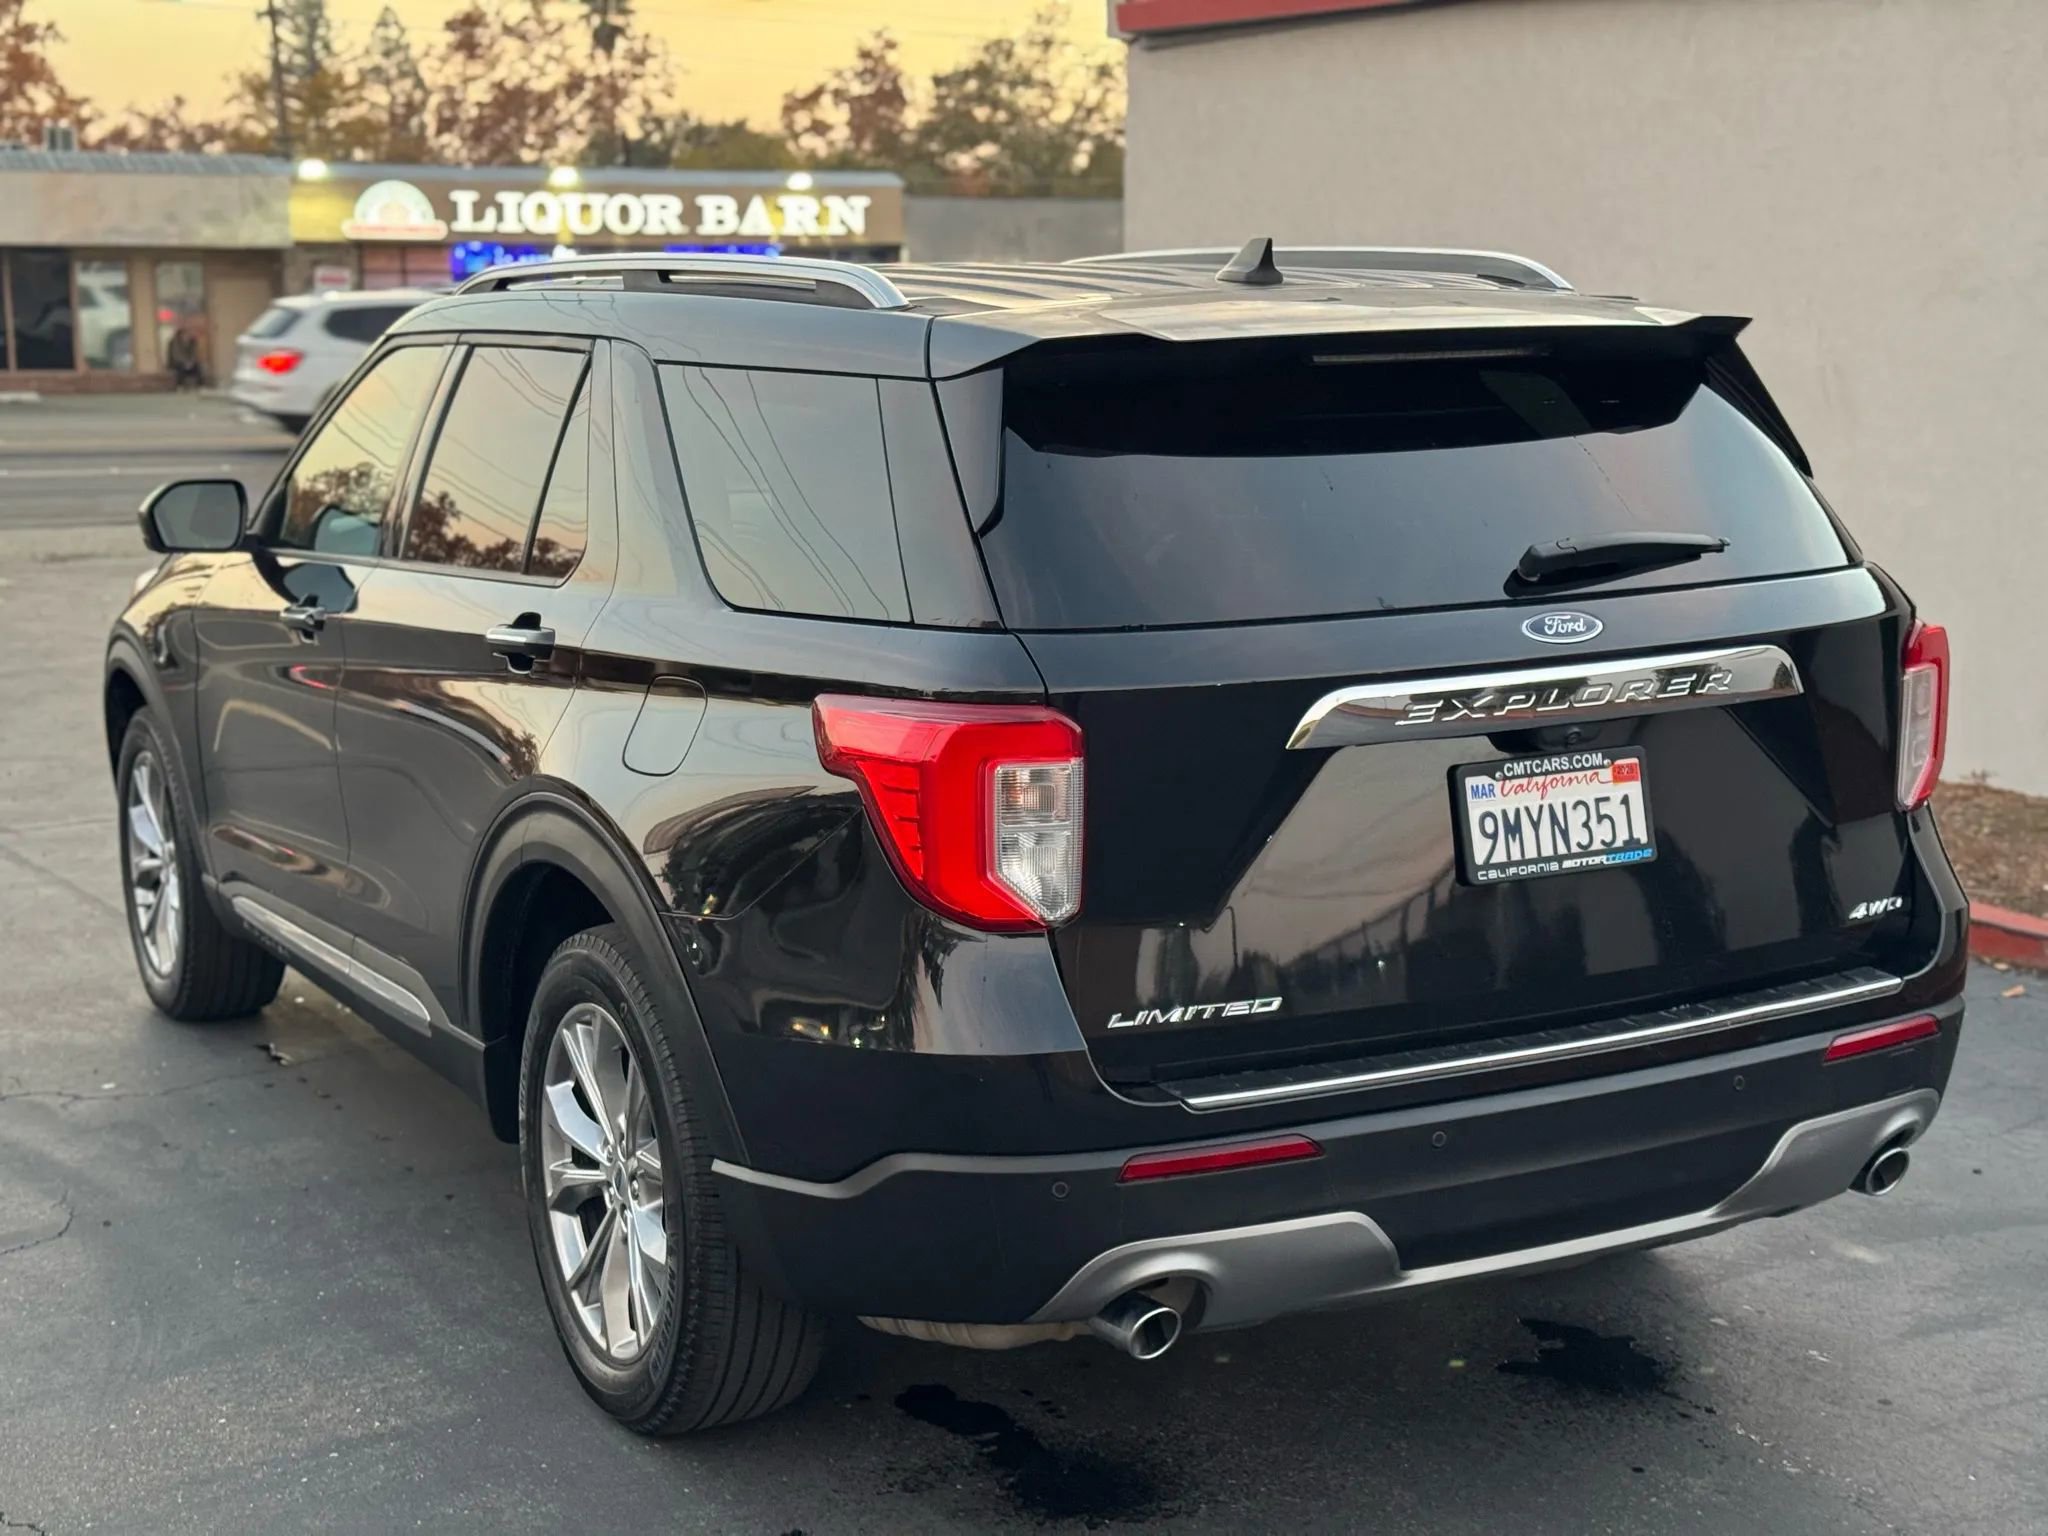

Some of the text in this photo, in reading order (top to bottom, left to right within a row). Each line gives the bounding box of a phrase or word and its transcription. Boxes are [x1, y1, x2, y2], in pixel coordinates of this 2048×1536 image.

[449, 190, 871, 236] LIQUOR BARN
[1544, 615, 1587, 635] Ford
[1394, 670, 1736, 727] EXPLORER
[1503, 753, 1603, 777] CMTCARS.COM
[1470, 783, 1496, 801] MAR
[1500, 771, 1606, 800] California
[1478, 794, 1642, 865] 9MYN351
[1848, 896, 1903, 920] 4WD
[1107, 996, 1283, 1029] LIMITED
